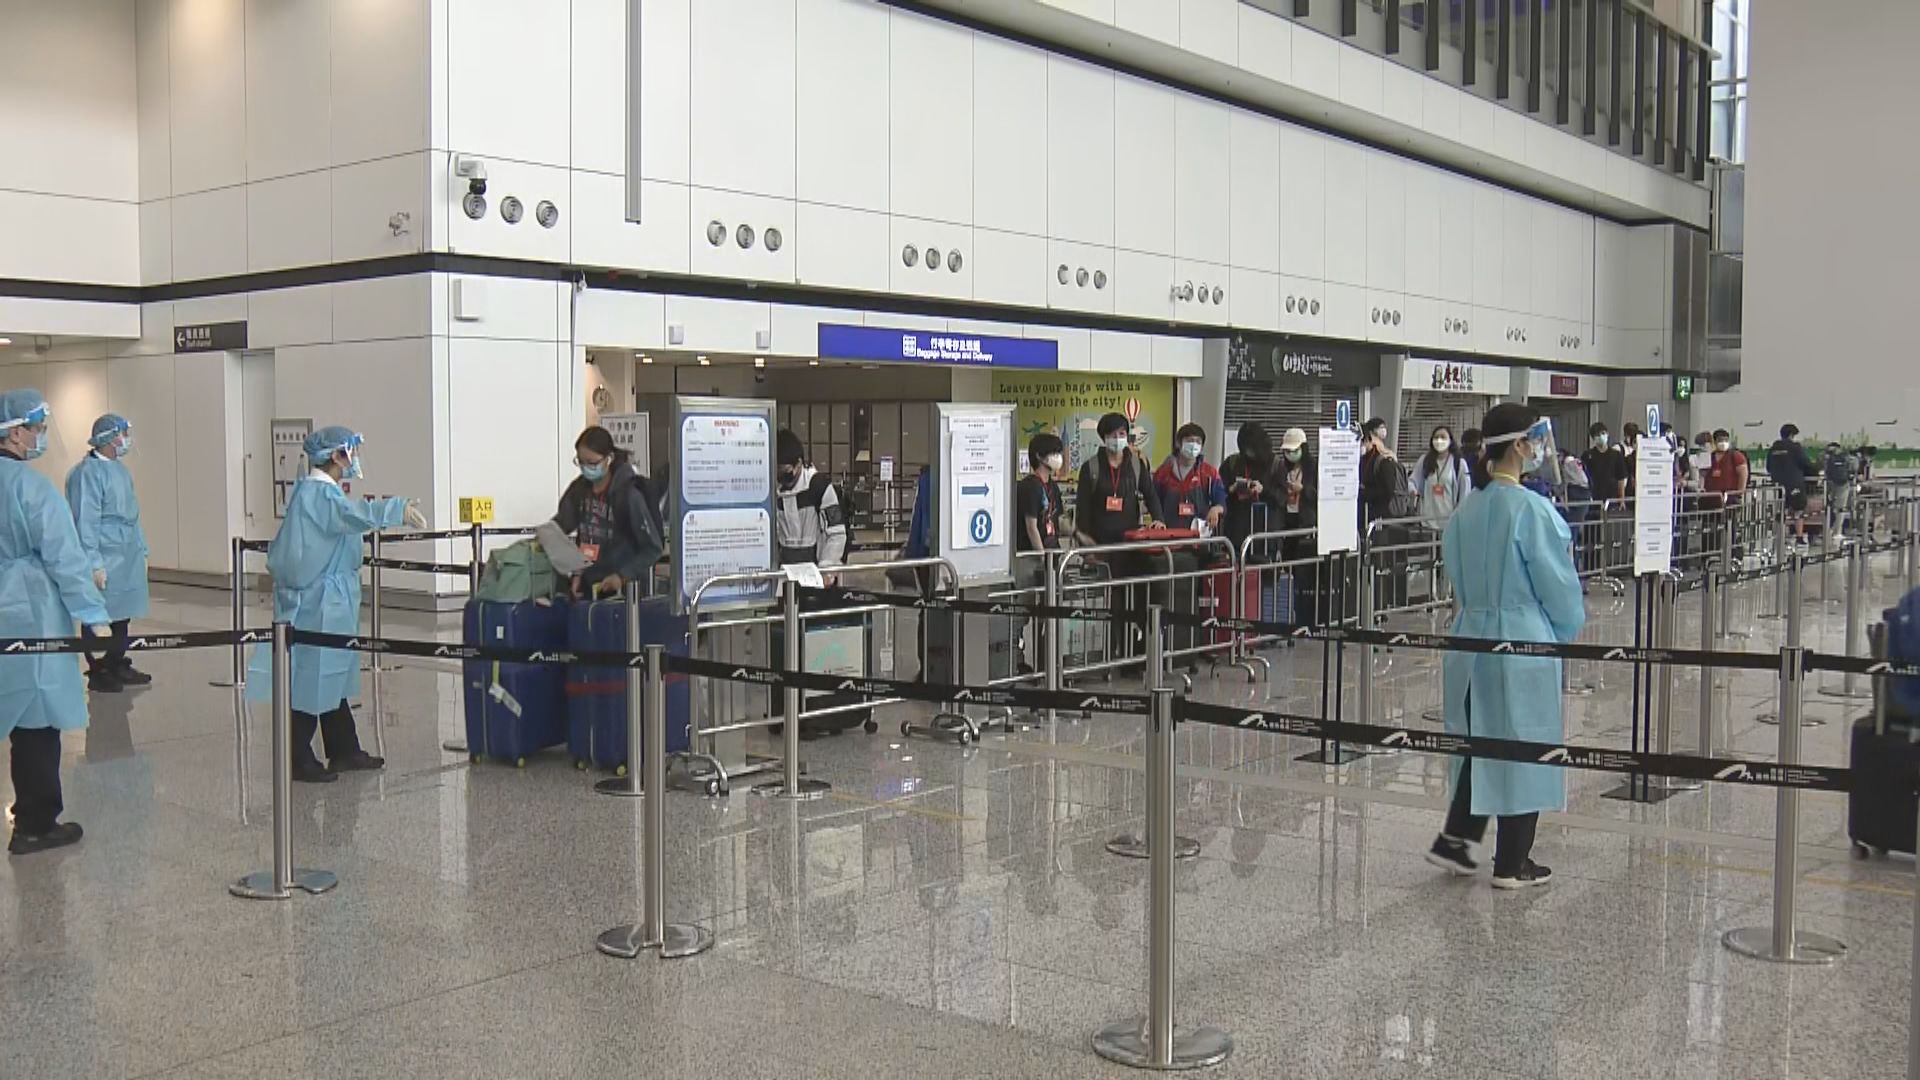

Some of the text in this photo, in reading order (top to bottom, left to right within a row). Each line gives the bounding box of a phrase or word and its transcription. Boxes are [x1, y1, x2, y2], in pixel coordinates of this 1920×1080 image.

[917, 347, 993, 363] Baggage Storage and Delivery
[1000, 381, 1141, 395] Leave your bags with us
[1023, 396, 1066, 409] explore
[1070, 396, 1089, 407] the
[1092, 396, 1121, 409] city!
[475, 501, 492, 511] 入口
[975, 514, 987, 538] 8
